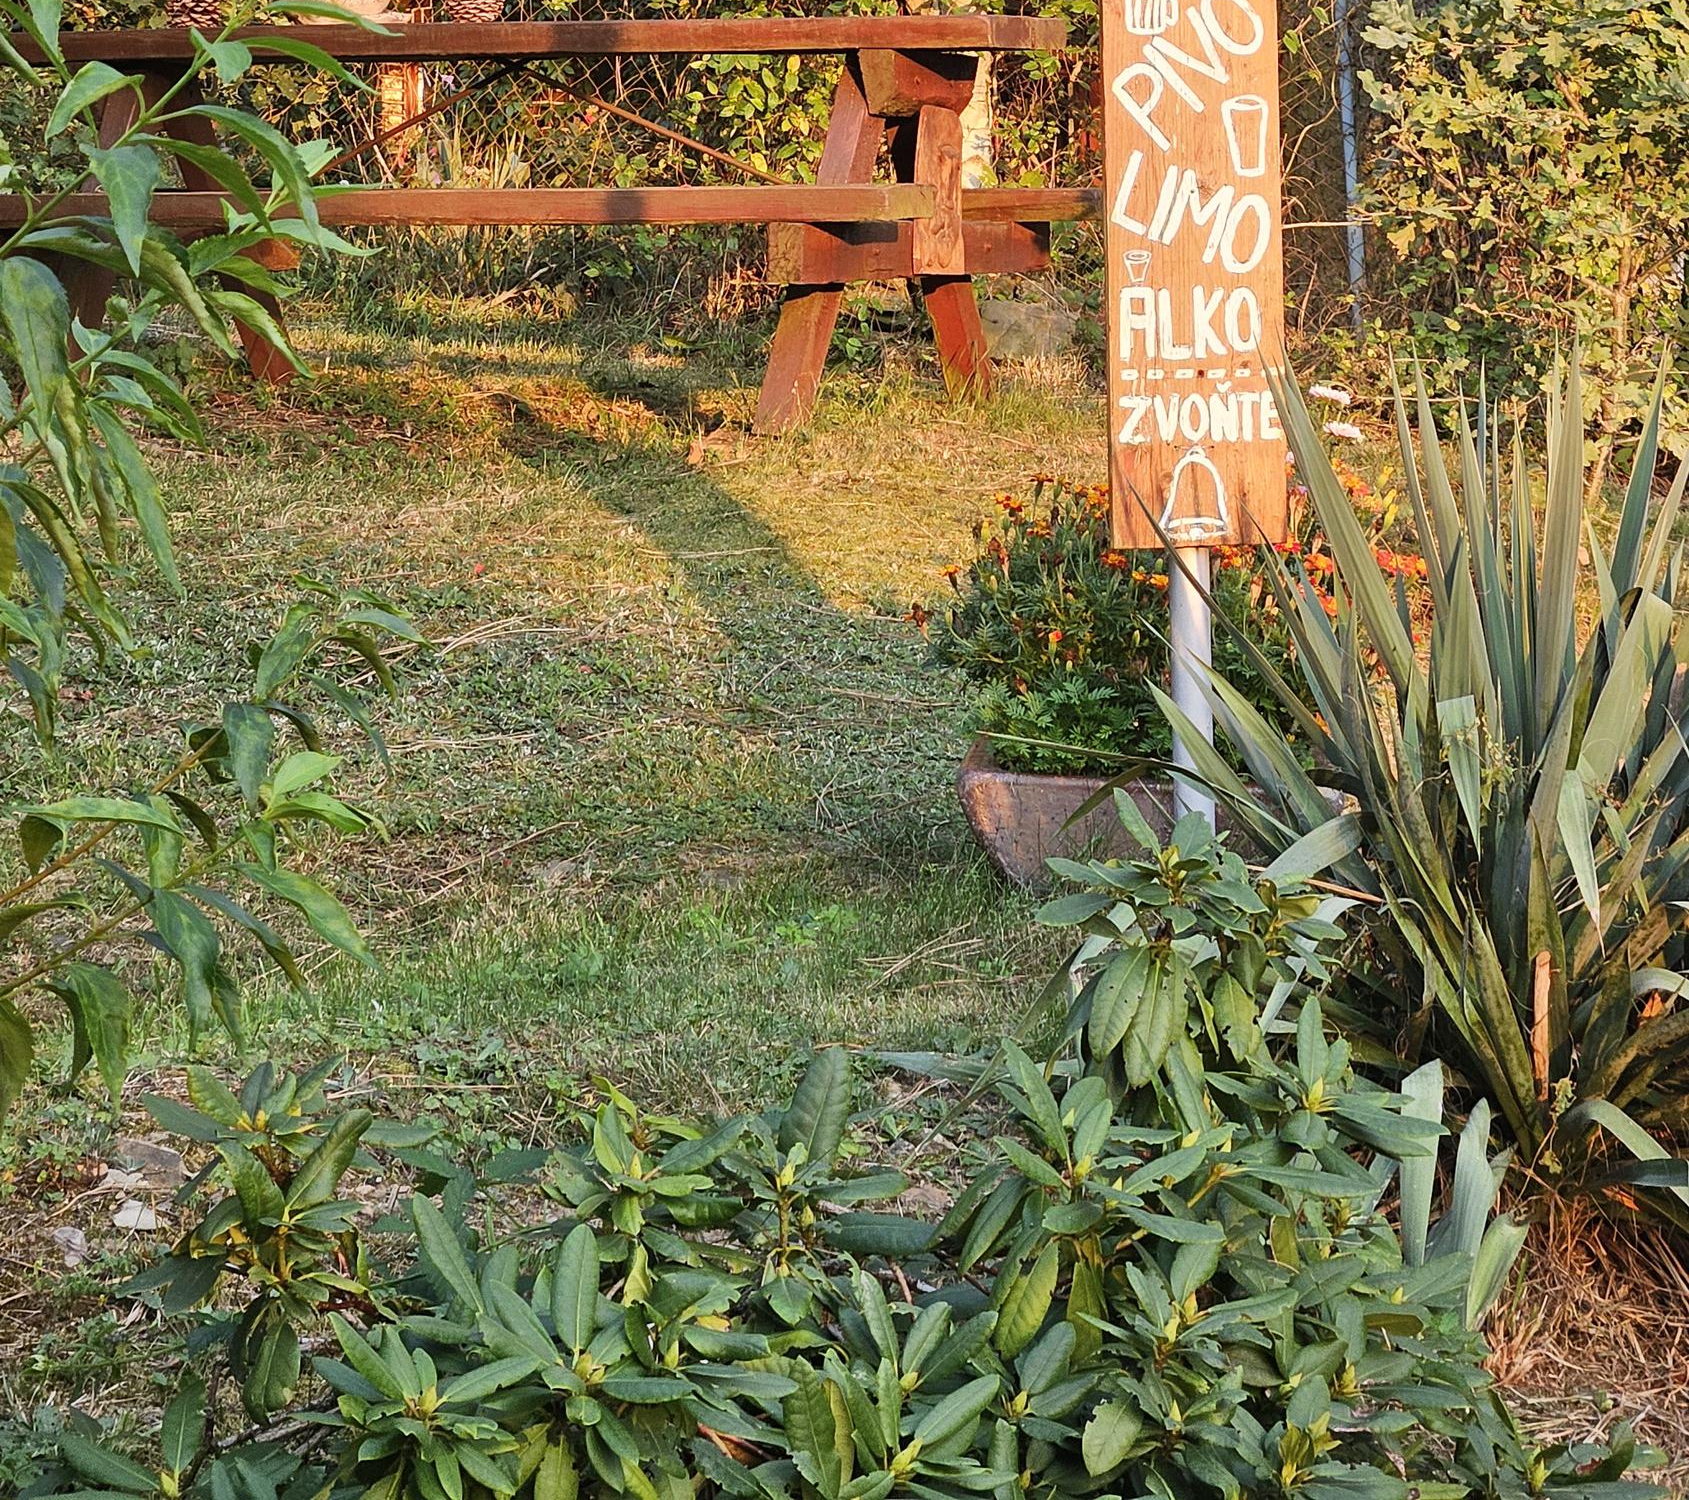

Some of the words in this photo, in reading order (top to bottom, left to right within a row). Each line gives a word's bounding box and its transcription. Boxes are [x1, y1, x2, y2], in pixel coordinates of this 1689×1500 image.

[1111, 149, 1271, 274] LIMO
[1119, 284, 1263, 362] ALKO
[1118, 381, 1283, 445] ZVOŇTE
